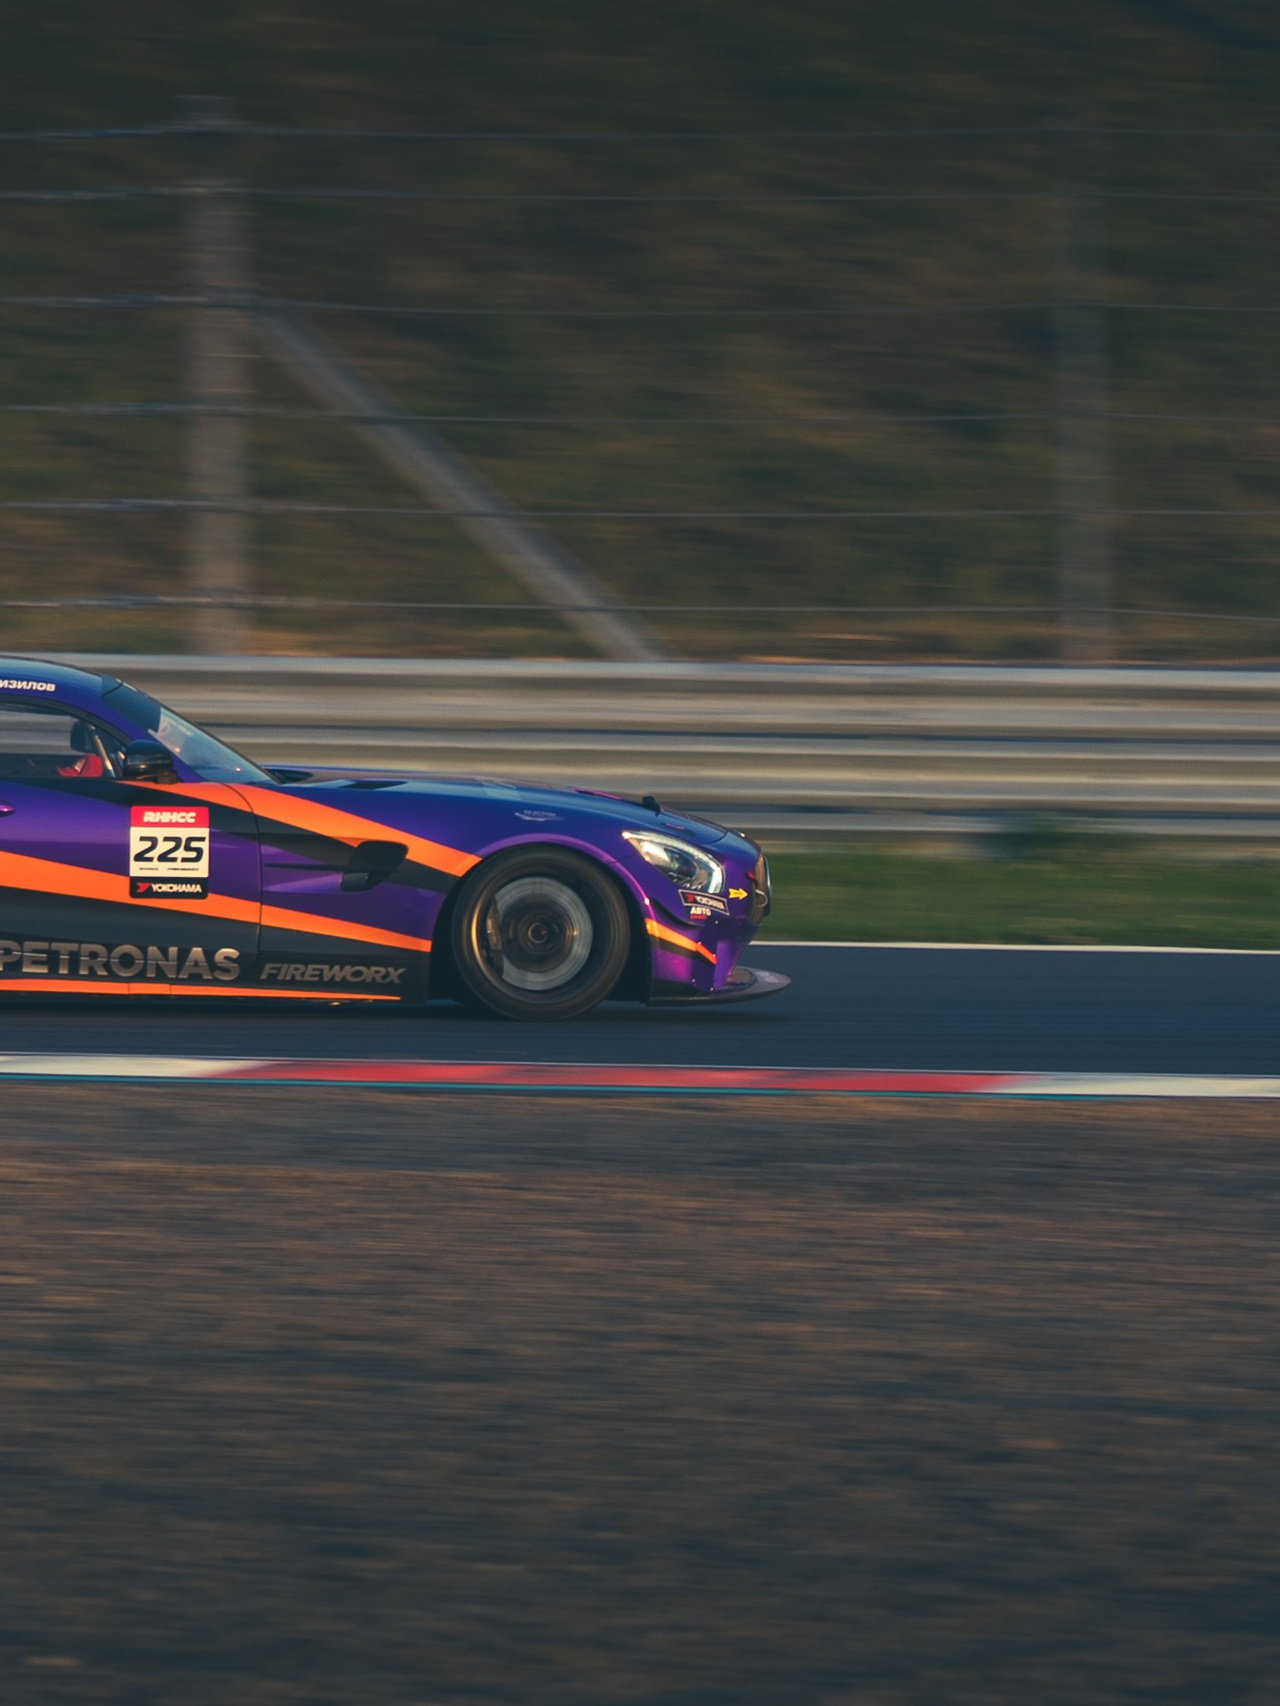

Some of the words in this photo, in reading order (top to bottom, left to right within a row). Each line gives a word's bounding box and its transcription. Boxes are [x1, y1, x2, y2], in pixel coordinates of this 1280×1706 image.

[143, 811, 196, 823] RHHCC
[133, 836, 206, 862] 225
[151, 883, 202, 892] YOKOHAMA
[260, 963, 406, 984] FIREWORX
